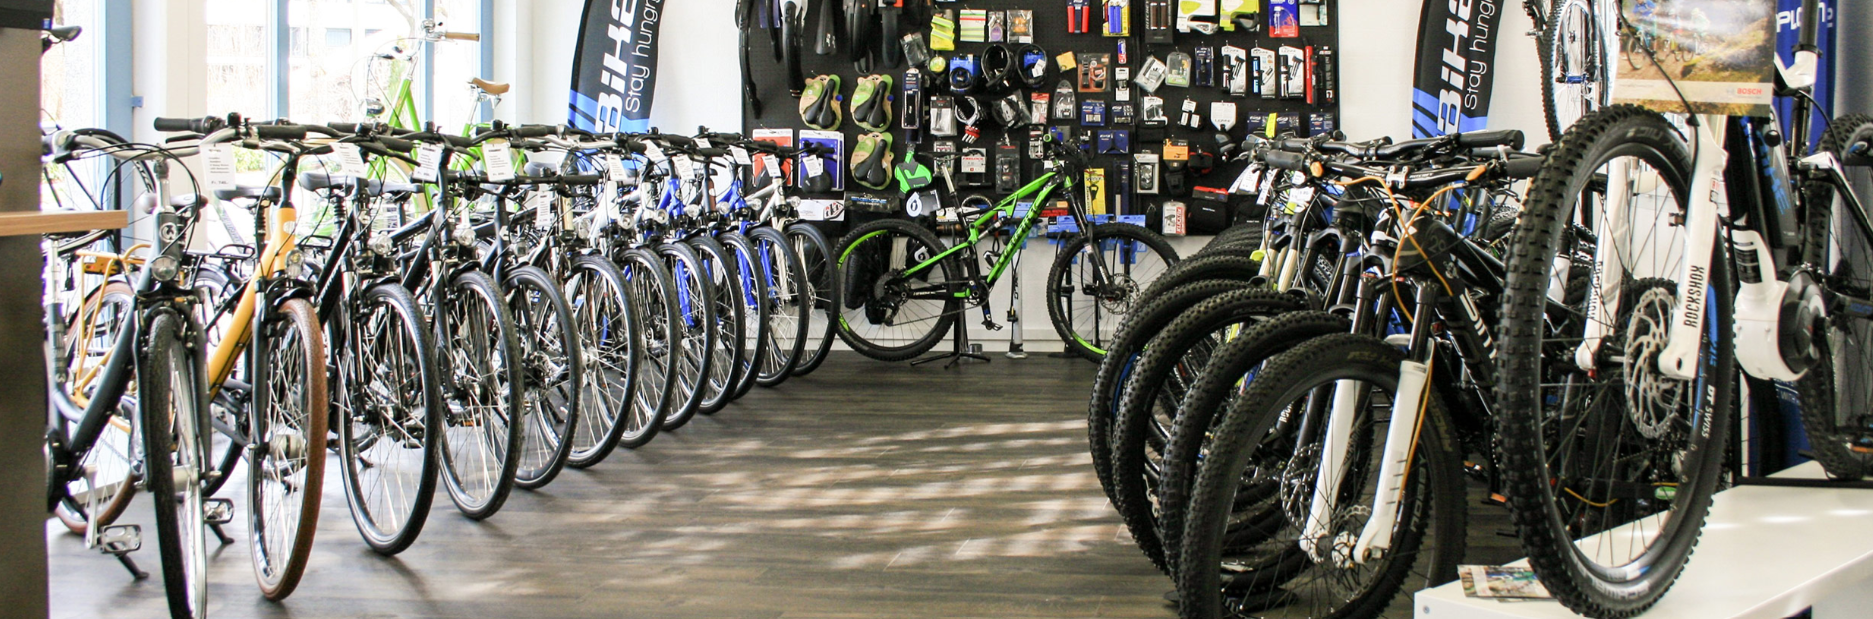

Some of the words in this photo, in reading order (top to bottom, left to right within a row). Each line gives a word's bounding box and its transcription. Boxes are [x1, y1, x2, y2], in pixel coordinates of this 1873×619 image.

[631, 0, 659, 58] hungr
[1469, 0, 1495, 53] hung
[625, 64, 650, 113] Stay
[1464, 60, 1487, 110] Stay
[1683, 265, 1705, 328] ROCKSHOX
[1706, 385, 1716, 406] DT
[1701, 405, 1713, 439] SWISS
